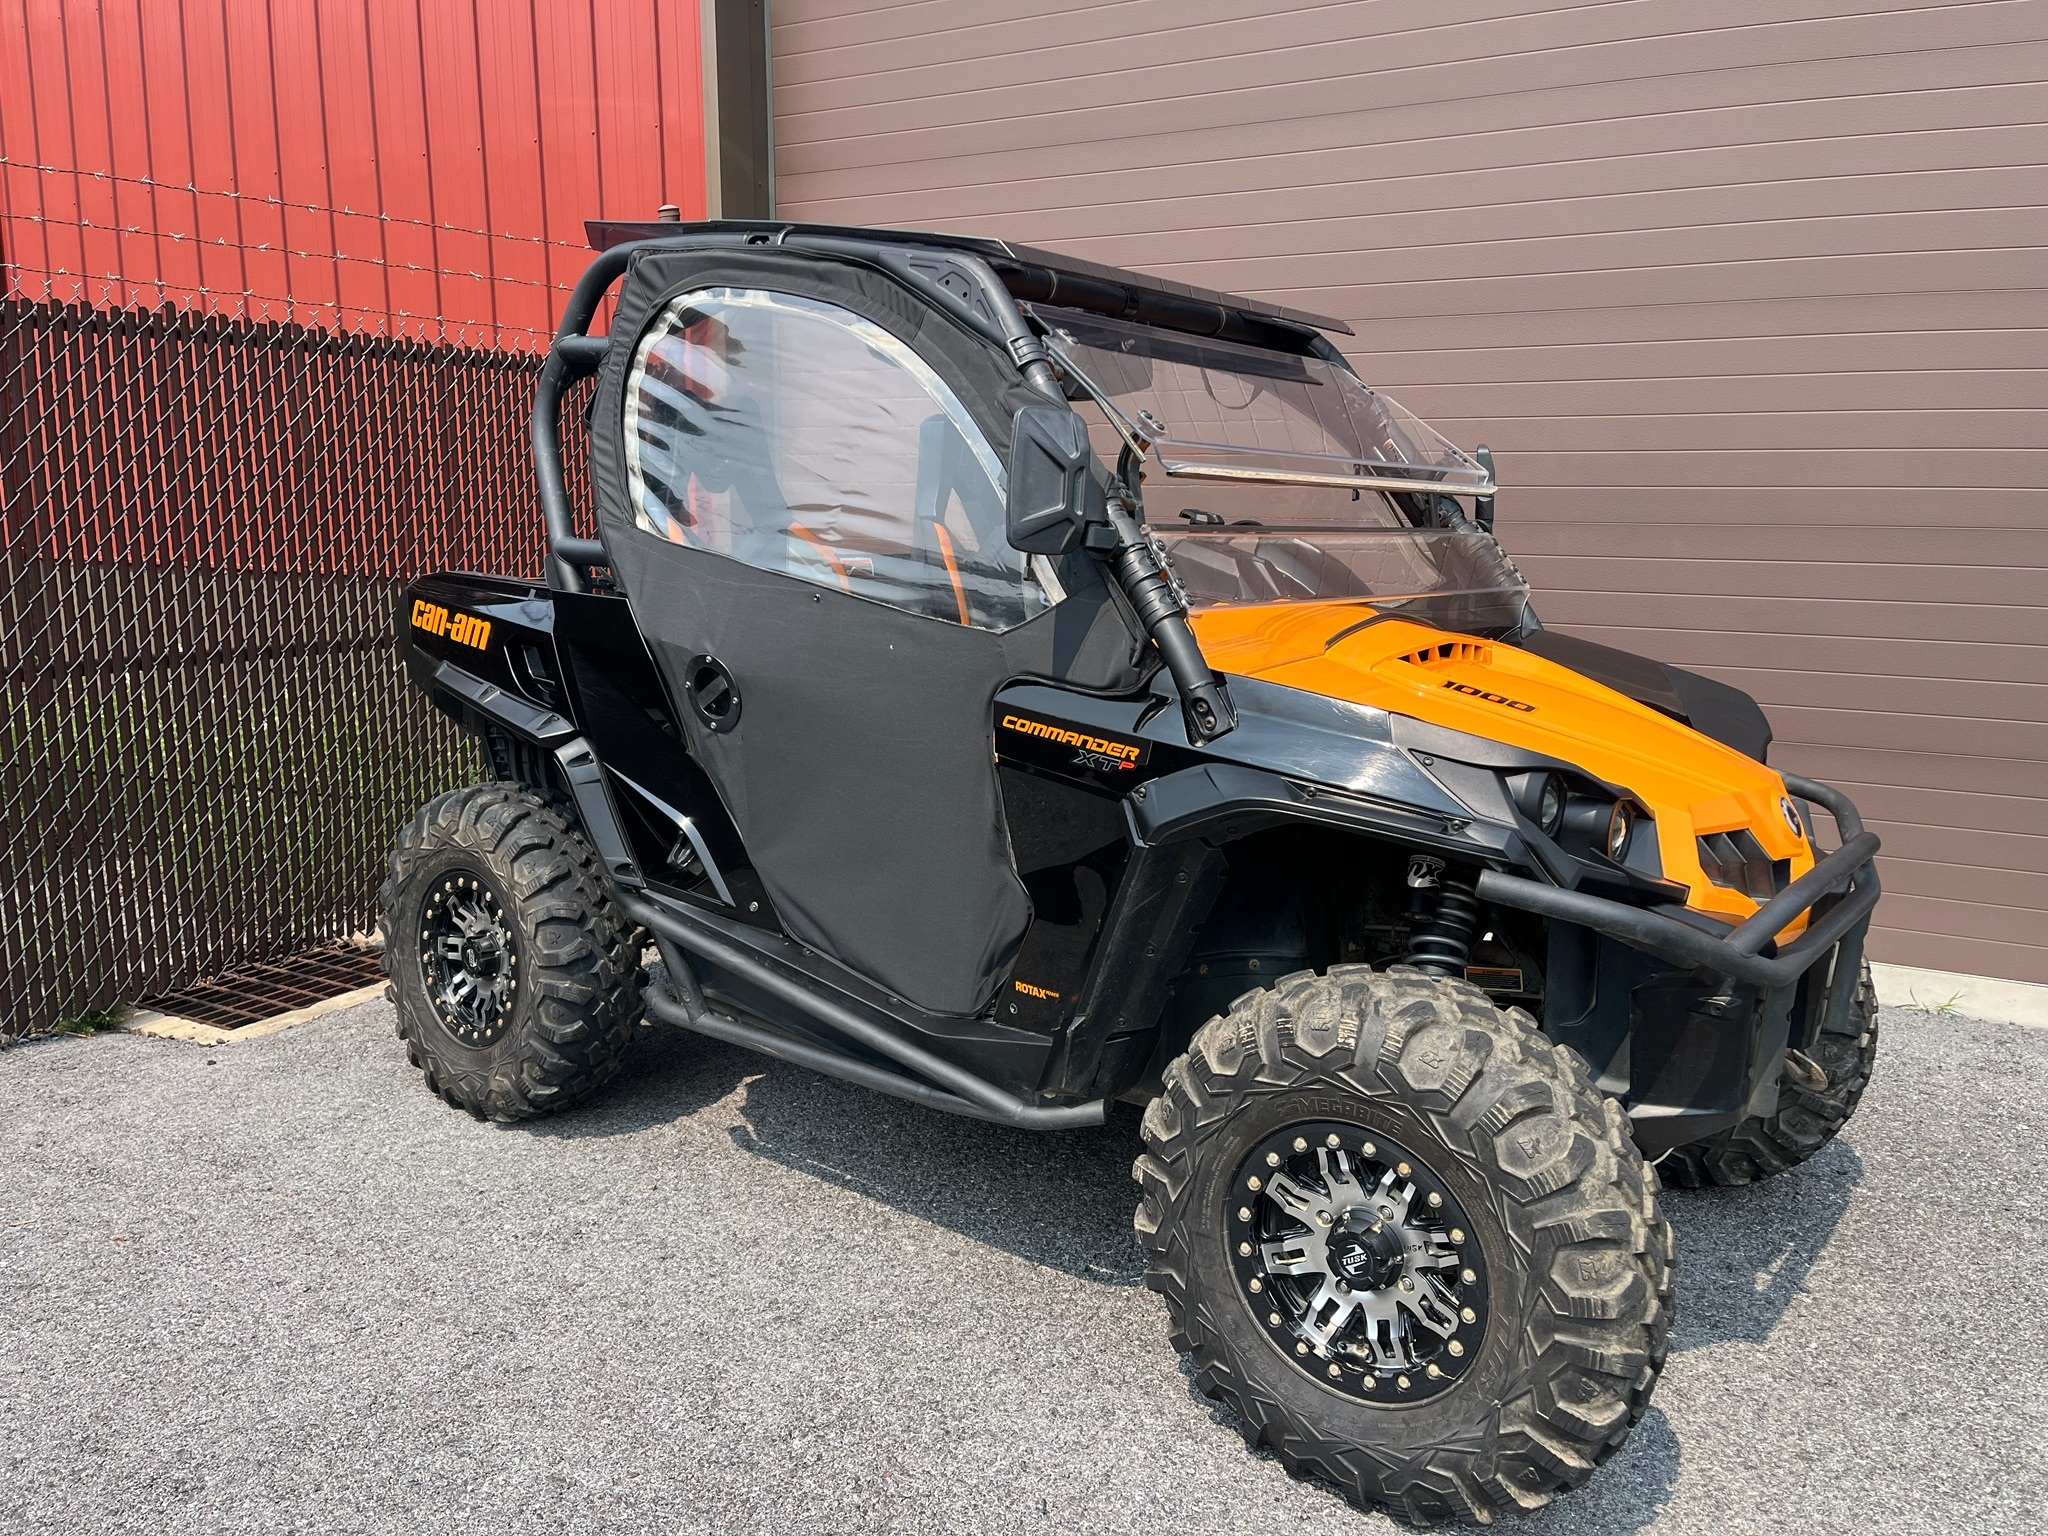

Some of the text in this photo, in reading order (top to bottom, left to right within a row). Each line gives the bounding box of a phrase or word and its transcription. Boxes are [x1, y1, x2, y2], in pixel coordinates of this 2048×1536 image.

[412, 599, 491, 650] can-am
[1442, 680, 1536, 712] 1000
[1002, 715, 1140, 761] COMMANDER
[1015, 981, 1046, 999] ROTAX
[1297, 1096, 1403, 1135] MEGABITE
[1341, 1253, 1368, 1266] TUSK
